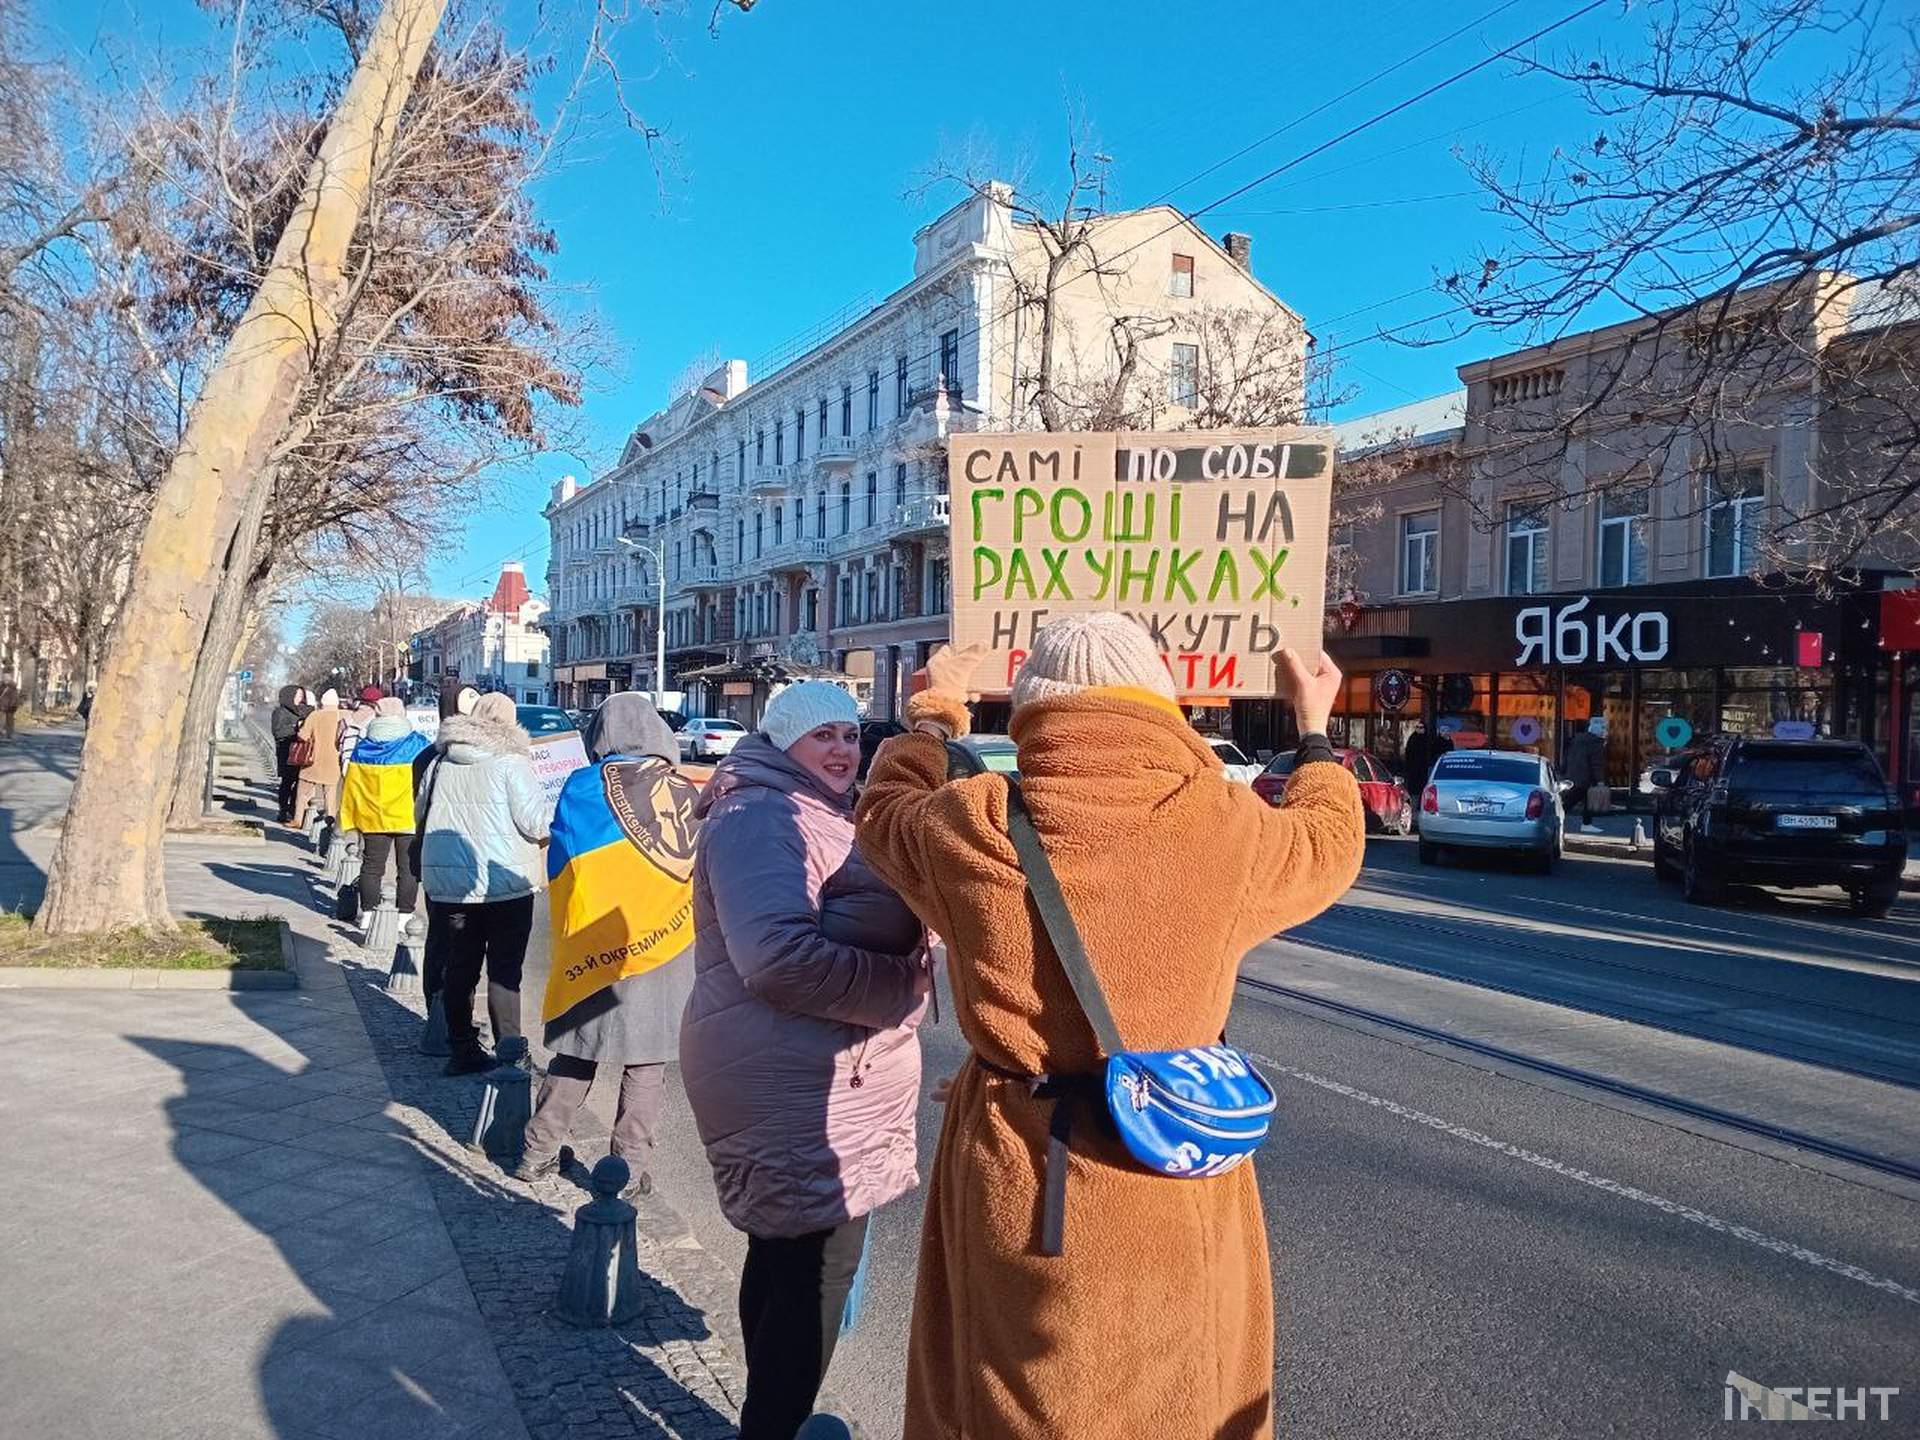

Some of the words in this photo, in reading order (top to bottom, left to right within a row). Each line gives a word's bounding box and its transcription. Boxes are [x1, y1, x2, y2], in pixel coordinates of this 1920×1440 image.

[1127, 446, 1177, 482] ПО
[1201, 443, 1291, 481] СОБІ
[970, 485, 1183, 544] ГРОШІ
[1514, 595, 1669, 667] Ябко
